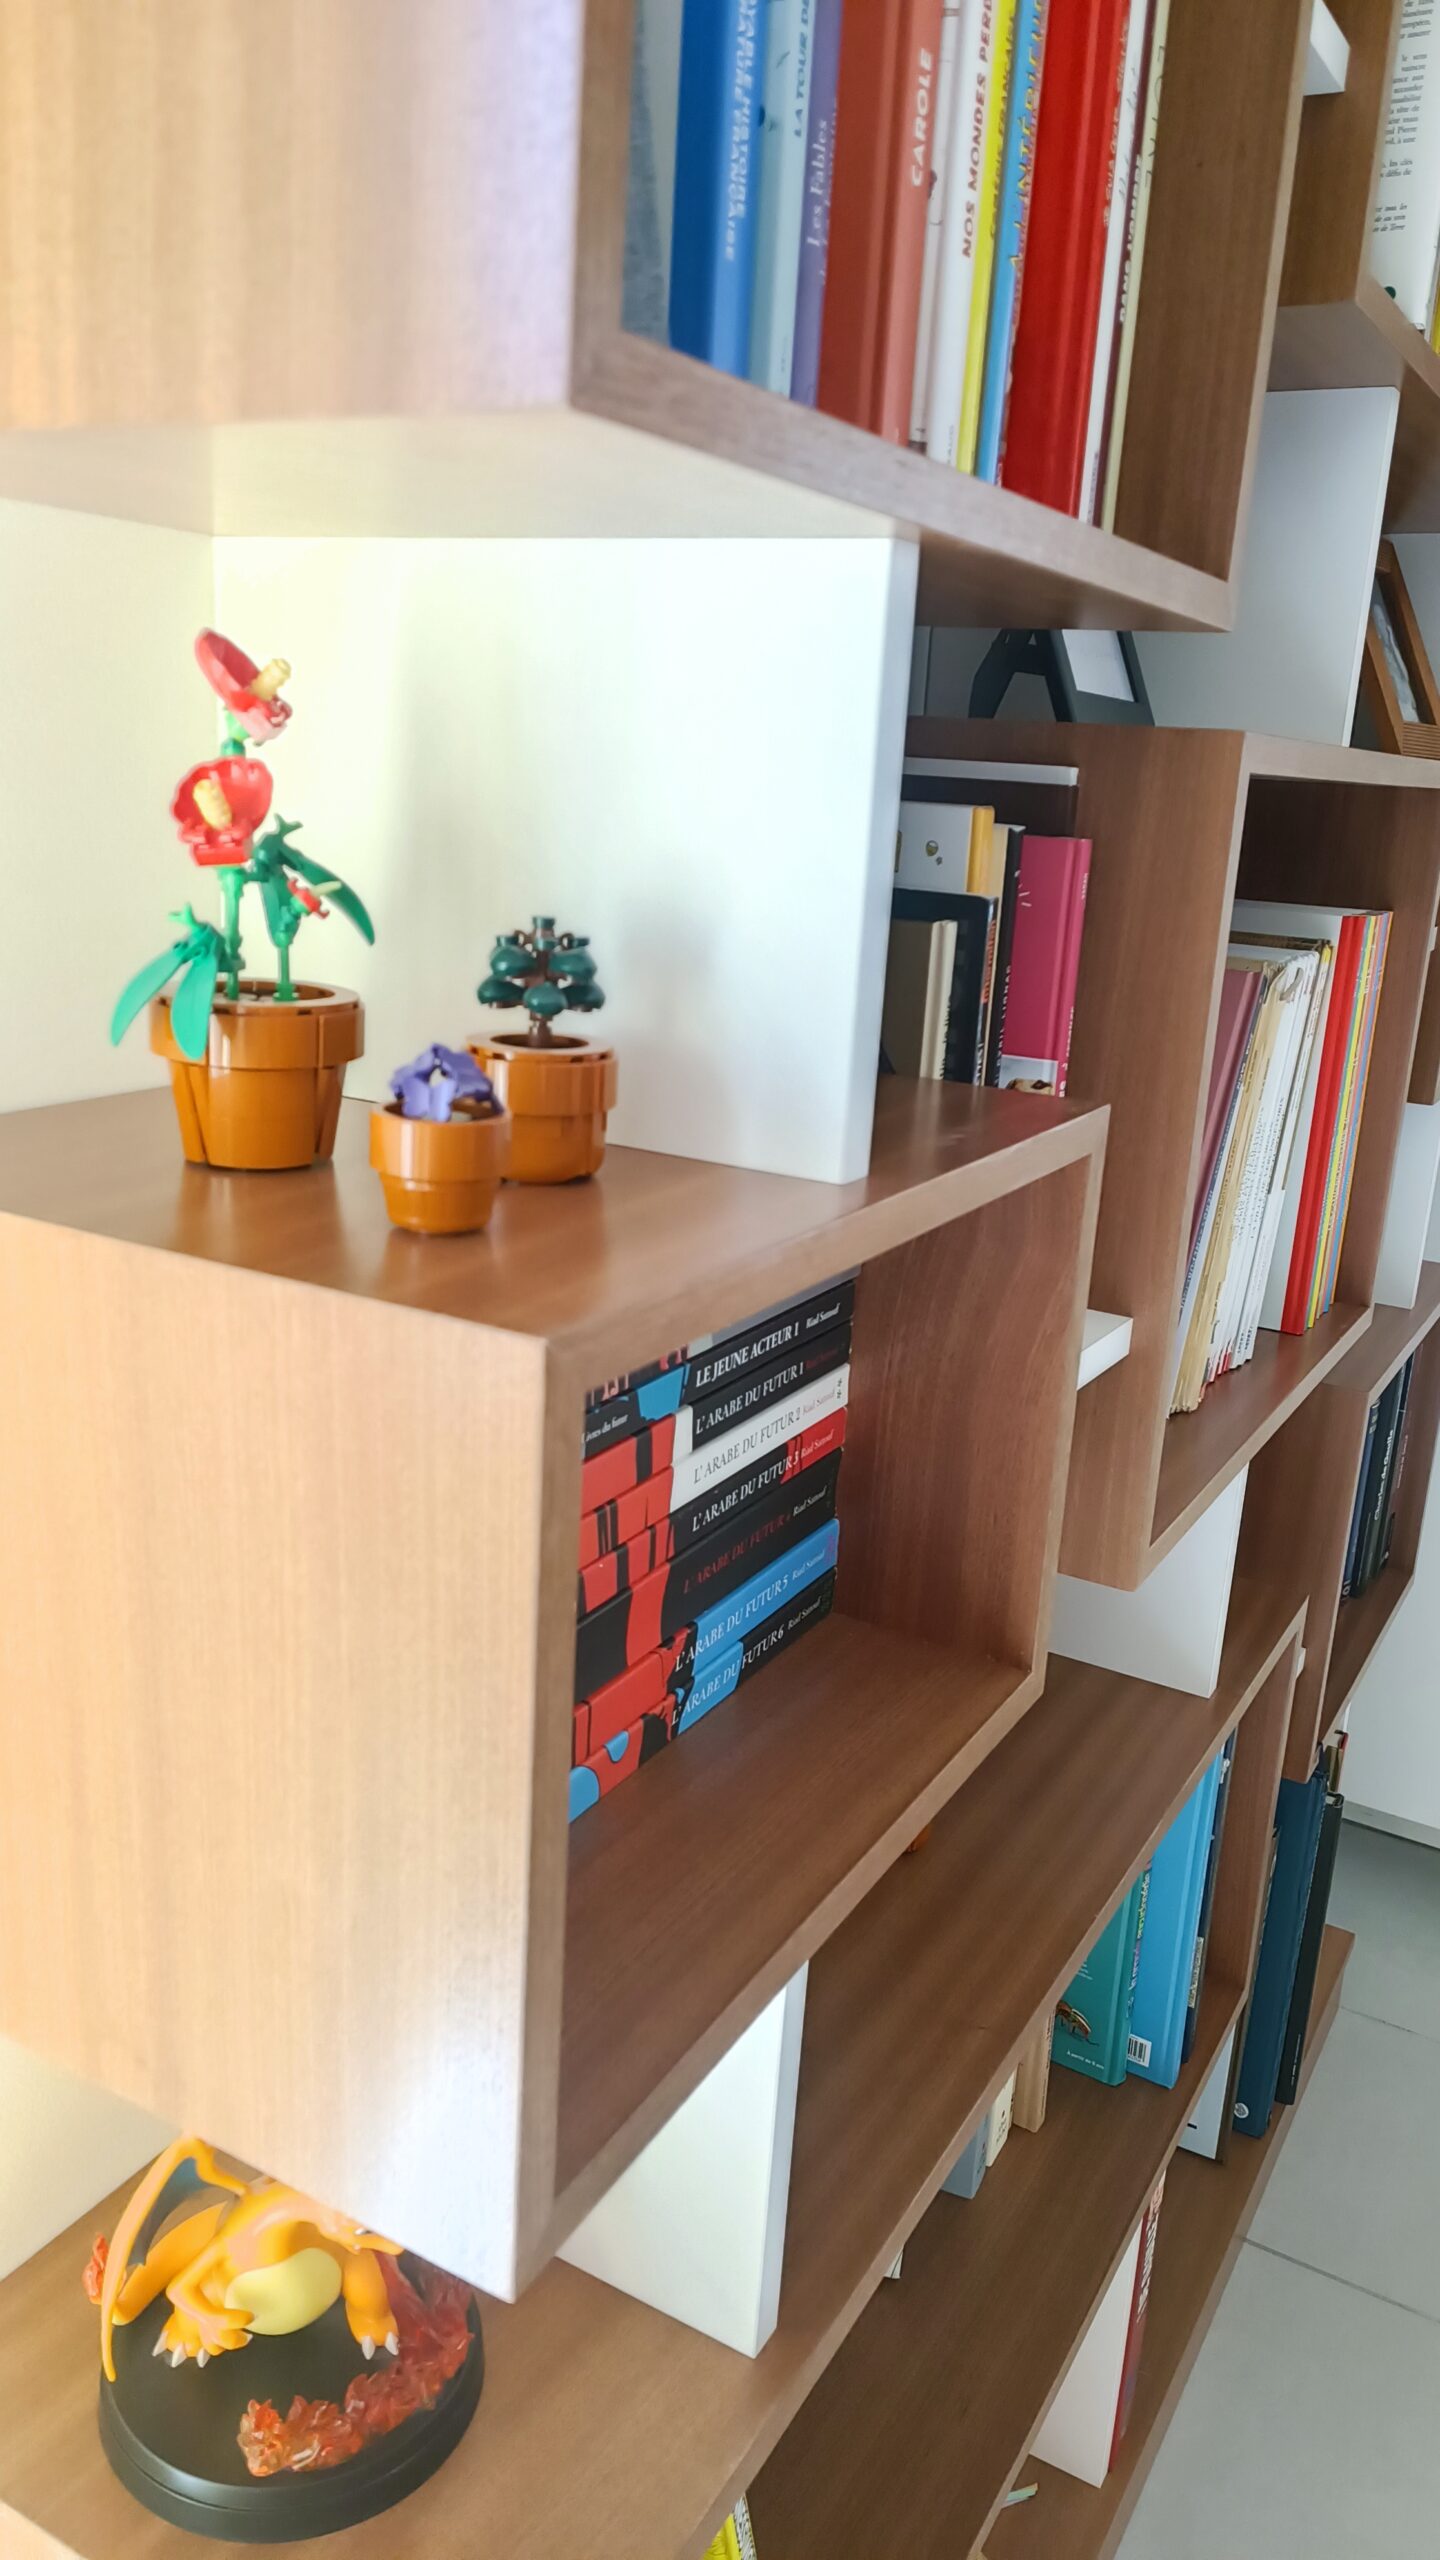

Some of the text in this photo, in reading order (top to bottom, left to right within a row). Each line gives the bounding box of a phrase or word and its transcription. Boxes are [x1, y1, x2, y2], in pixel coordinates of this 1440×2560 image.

[796, 32, 808, 99] TOUR
[794, 108, 804, 138] LA
[911, 46, 934, 188] CAROLE
[967, 71, 987, 193] MONDES
[806, 118, 828, 248] Les Fables
[961, 199, 976, 260] NOS
[695, 1361, 712, 1388] LE
[711, 1345, 750, 1382] JEUNE
[750, 1328, 793, 1360] ACTEUR
[794, 1321, 800, 1337] 1
[695, 1395, 744, 1435] L'ARABE
[744, 1385, 762, 1407] DU
[762, 1365, 799, 1397] FUTUR
[693, 1442, 741, 1485] L'ARABE
[741, 1432, 759, 1454] DU
[759, 1411, 795, 1446] FUTUR
[795, 1406, 801, 1421] 2
[1374, 1479, 1386, 1521] Charles
[1383, 1429, 1394, 1465] Gaulle
[691, 1490, 739, 1532] L'ARABE
[739, 1478, 757, 1500] DU
[757, 1456, 793, 1489] FUTUR
[792, 1450, 799, 1465] 3
[730, 1540, 746, 1561] DU
[750, 1514, 786, 1548] FUTUR
[675, 1623, 726, 1673] L'ARABE
[726, 1608, 744, 1633] DU
[744, 1582, 782, 1619] FUTUR
[781, 1574, 789, 1590] 5
[671, 1675, 721, 1726] L'ARABE
[722, 1660, 741, 1685] DU
[741, 1631, 779, 1670] FUTUR
[777, 1623, 785, 1639] 6
